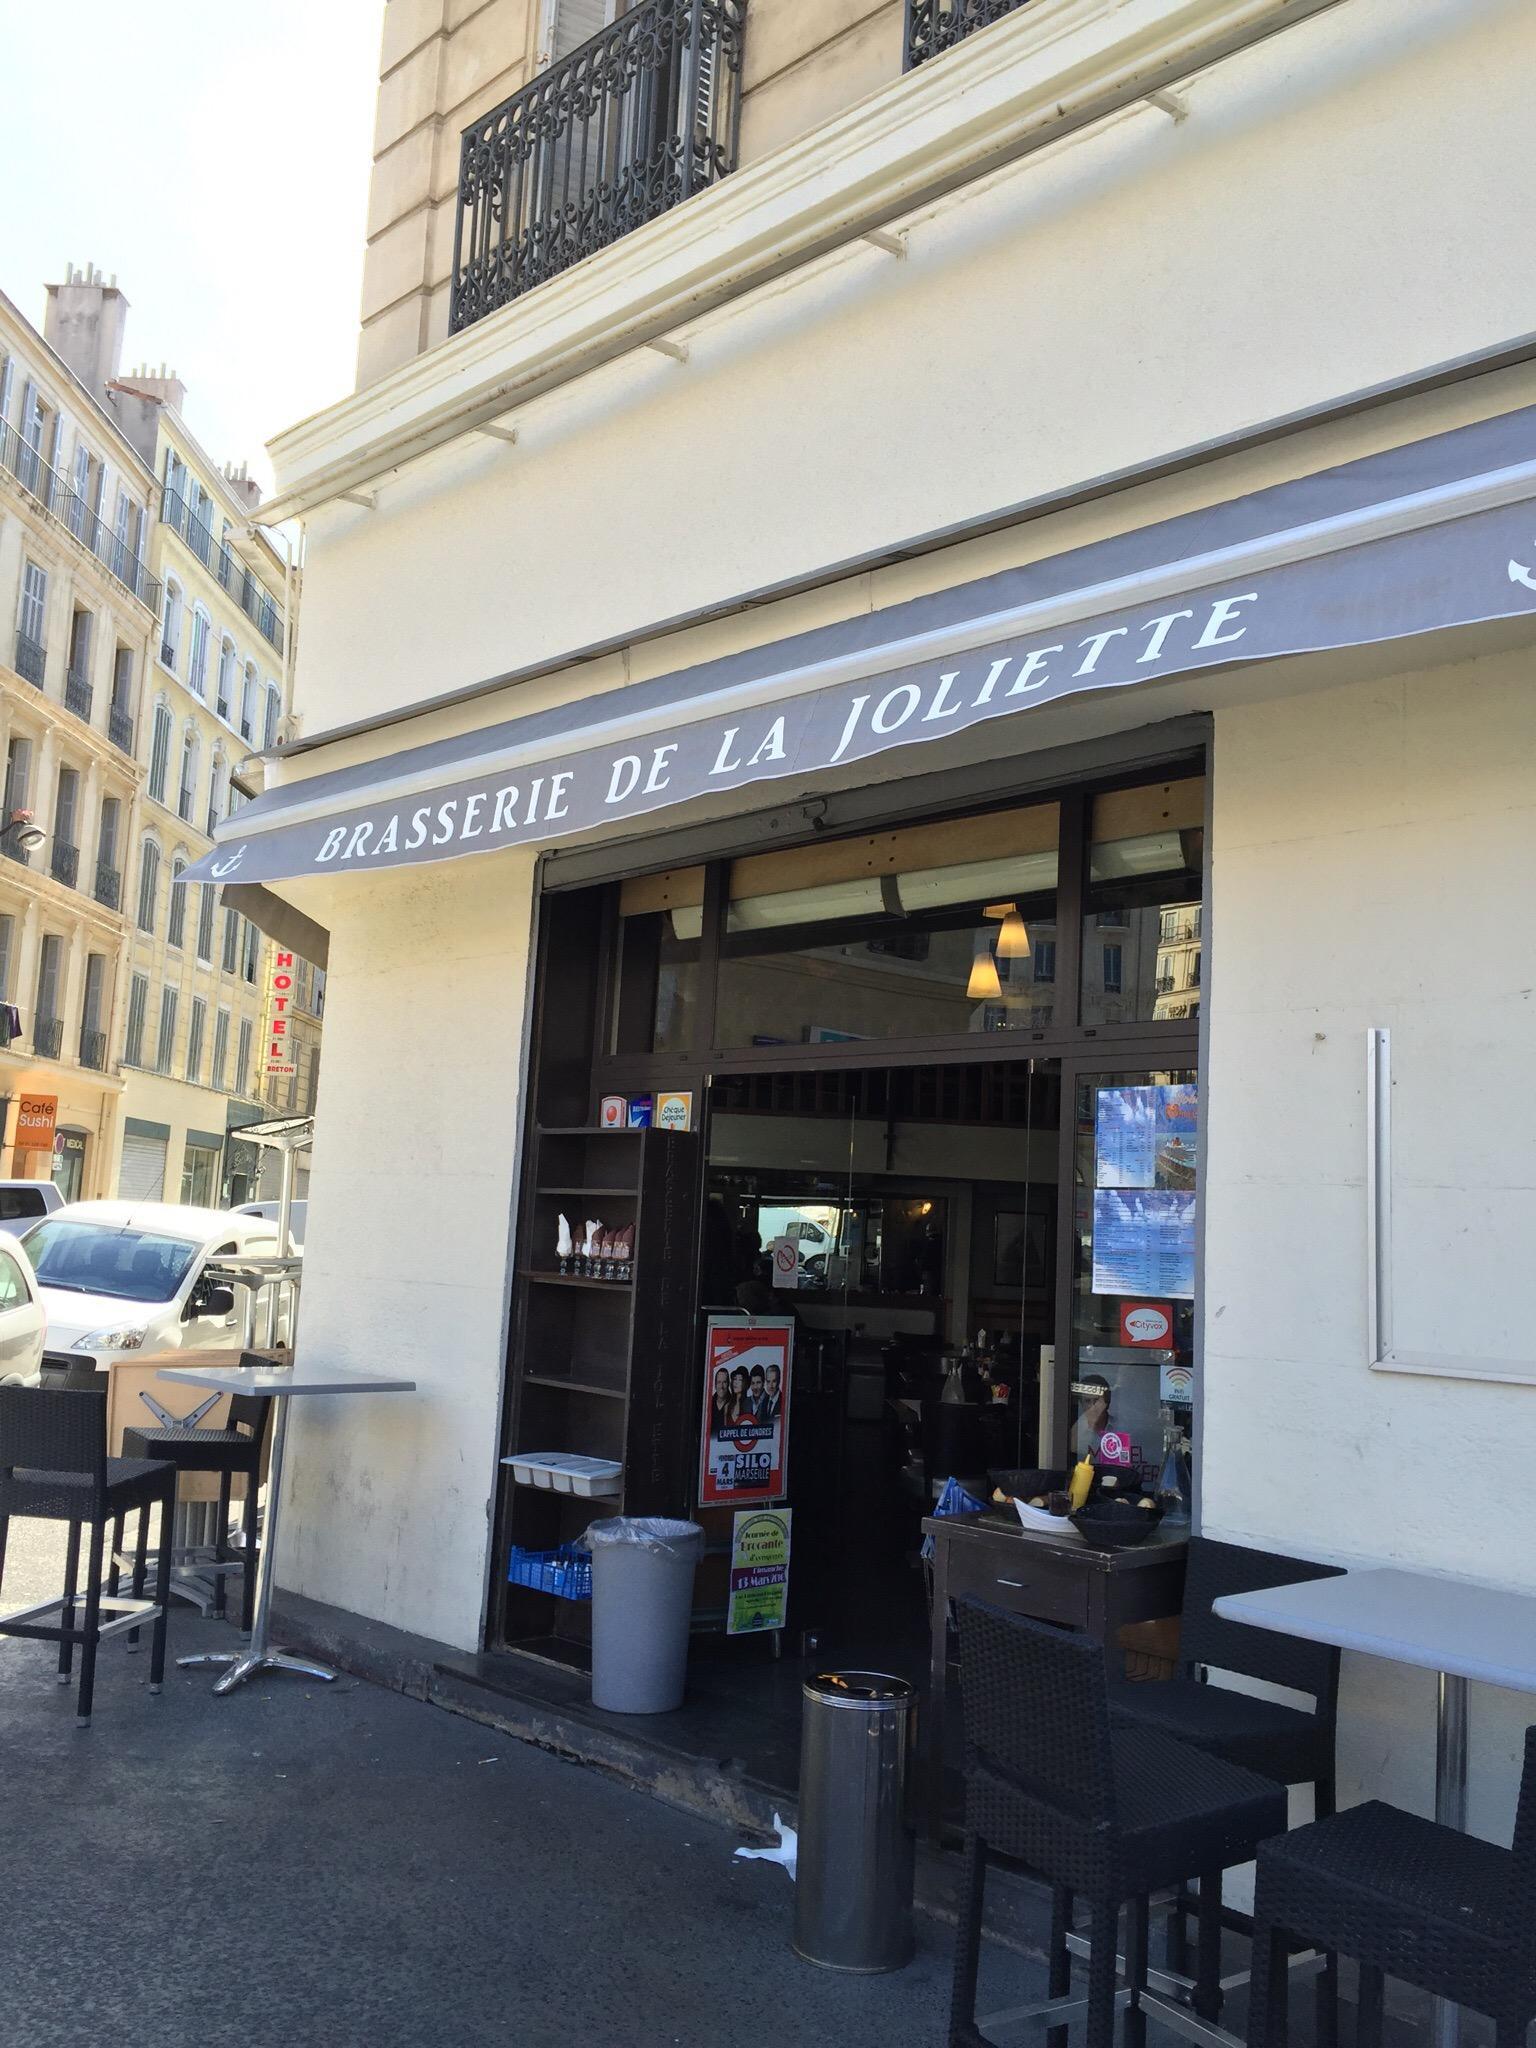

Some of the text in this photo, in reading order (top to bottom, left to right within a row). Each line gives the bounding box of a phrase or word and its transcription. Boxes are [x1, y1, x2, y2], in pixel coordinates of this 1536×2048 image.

[314, 592, 1259, 864] BRASSERIE DE LA JOLIETTE
[272, 952, 294, 1058] HOTEL
[266, 1065, 294, 1073] BRETON
[20, 1101, 54, 1115] Café
[19, 1114, 54, 1128] Sushi
[1135, 1319, 1164, 1330] Cityvox
[719, 1426, 772, 1439] L'APPEL DE LONDRES
[736, 1453, 771, 1469] SILO
[721, 1462, 730, 1477] 4
[734, 1468, 770, 1481] MARSEILLE
[717, 1478, 734, 1486] MARS
[737, 1576, 749, 1590] 13
